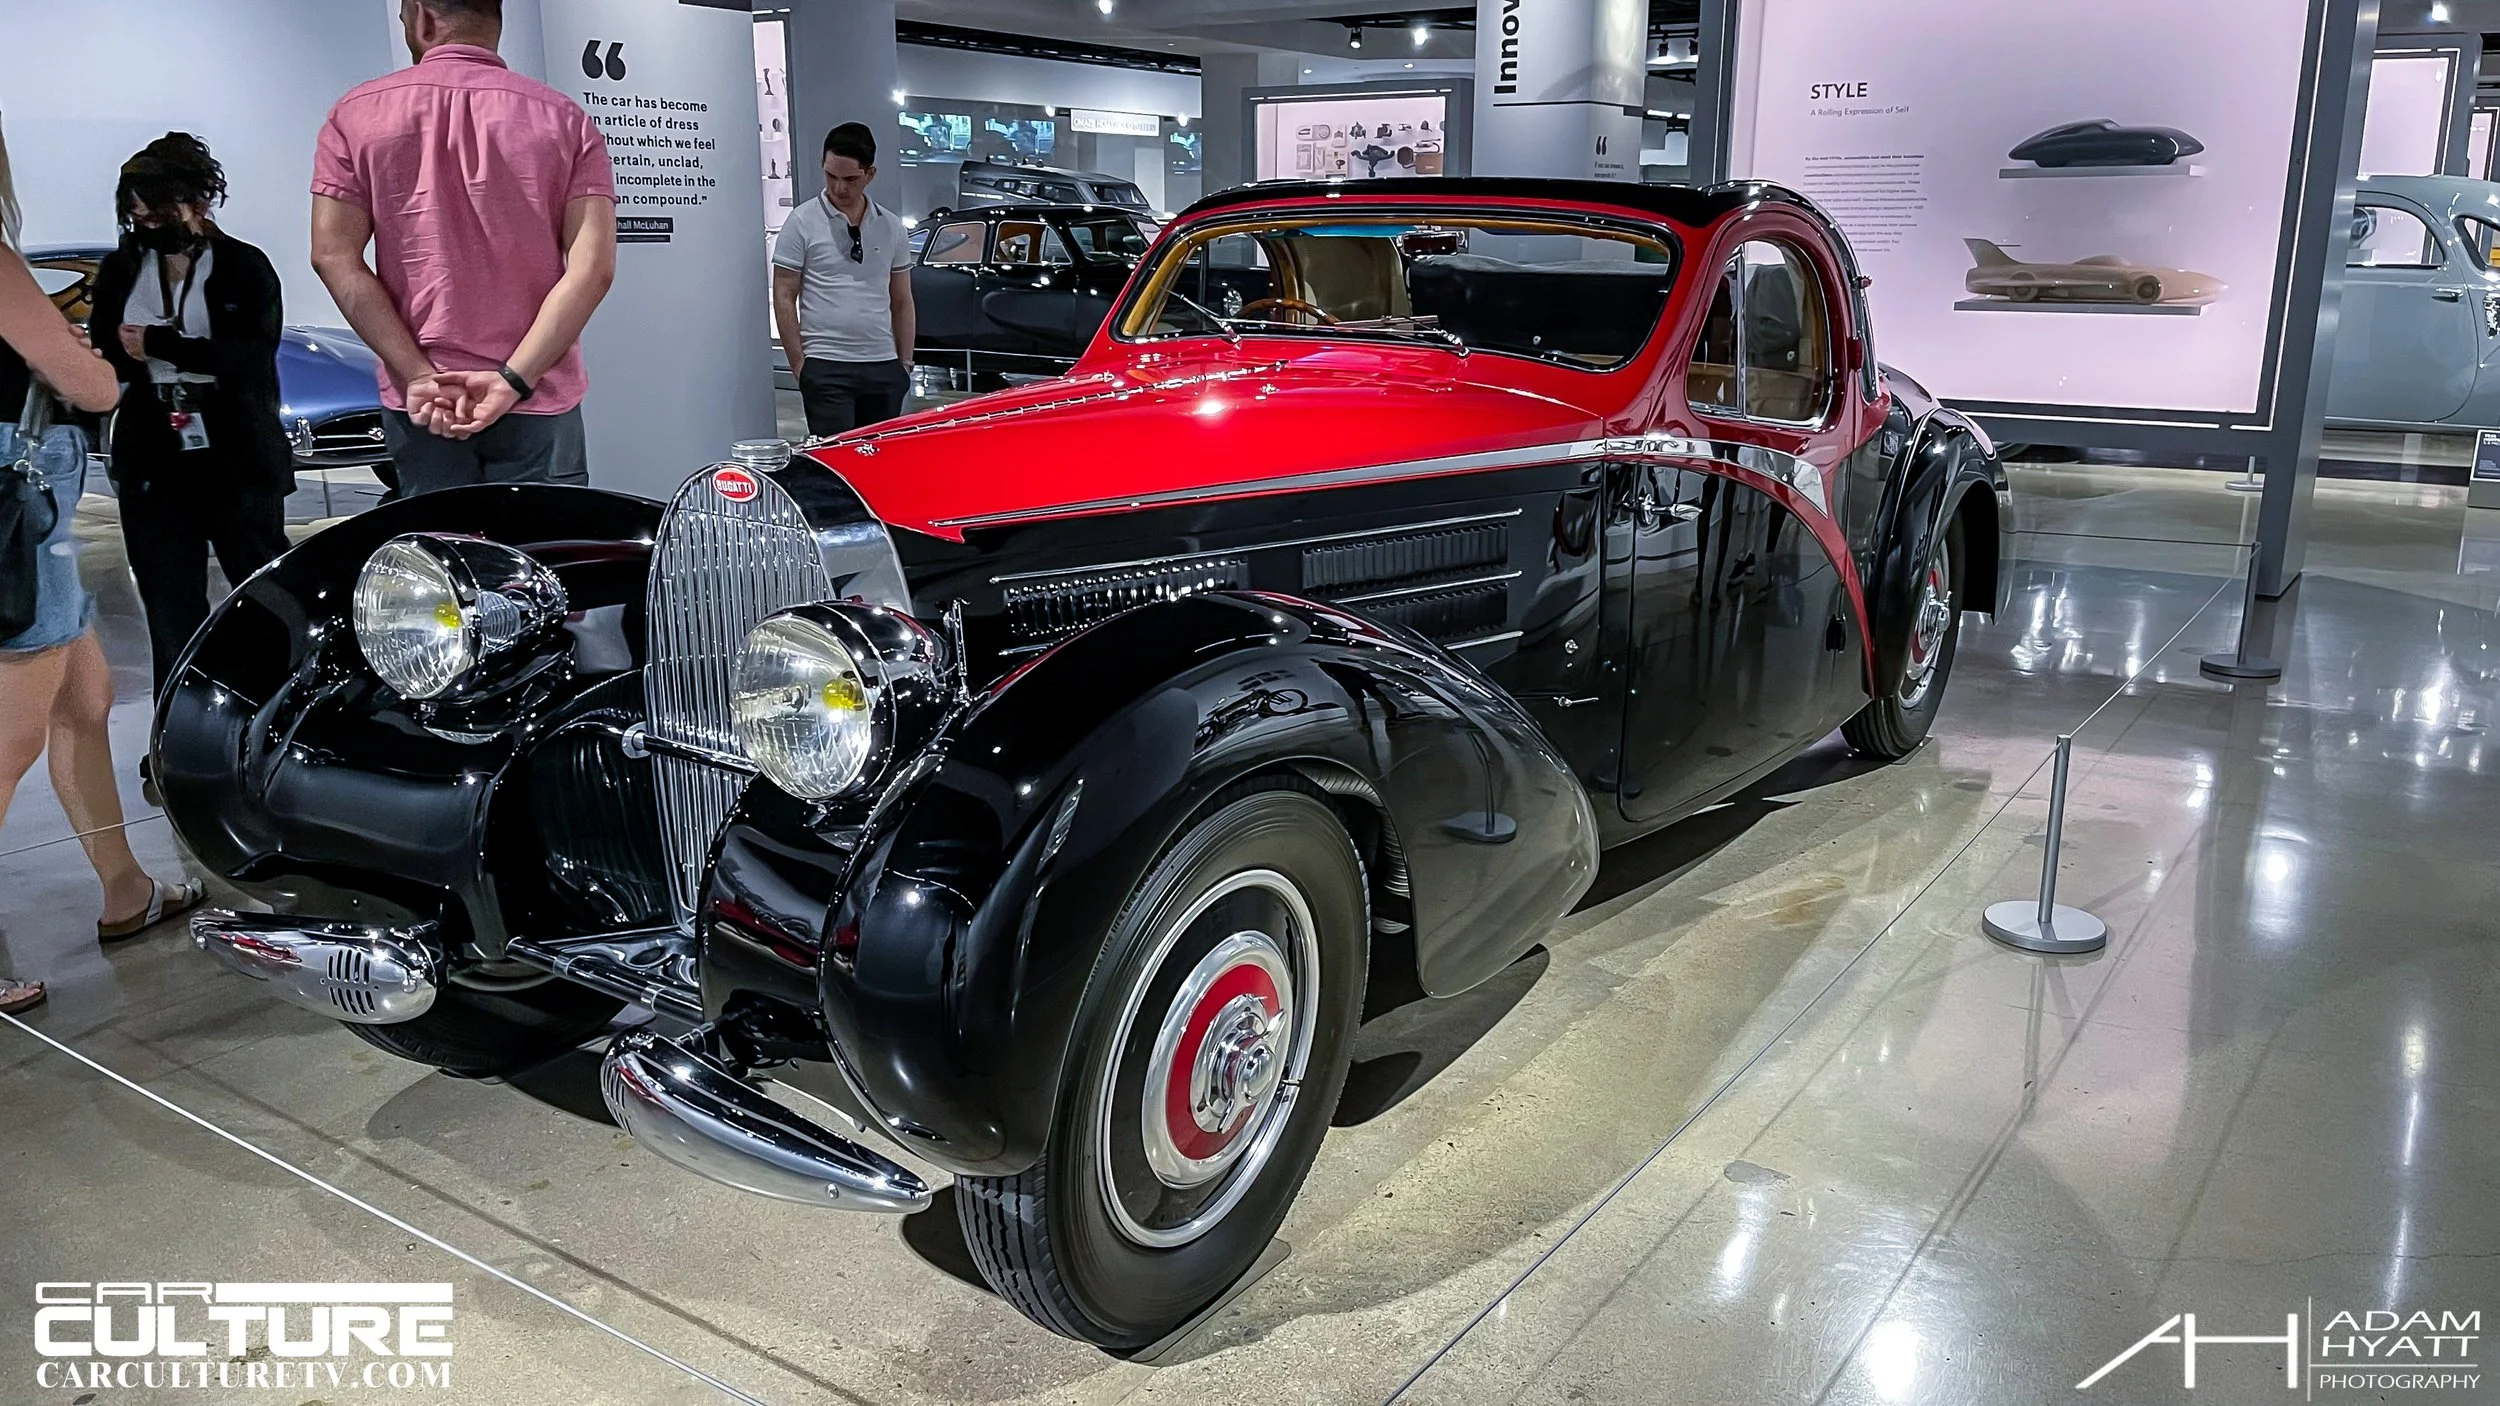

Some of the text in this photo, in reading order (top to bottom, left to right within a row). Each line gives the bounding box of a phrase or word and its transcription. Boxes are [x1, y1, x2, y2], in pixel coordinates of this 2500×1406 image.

[1810, 82, 1868, 100] STYLE
[583, 92, 708, 112] The car has become
[1818, 108, 1842, 117] Rolling
[1844, 107, 1884, 117] Expression
[1885, 106, 1894, 114] of
[1895, 105, 1910, 114] Self
[605, 114, 646, 127] article
[650, 116, 662, 128] of
[665, 117, 699, 131] dress
[637, 135, 672, 148] which
[675, 139, 691, 149] we
[694, 137, 716, 150] feel
[658, 156, 703, 169] unclad,
[615, 172, 716, 188] incomplete in the
[633, 220, 669, 230] McLuhan
[715, 479, 753, 494] BUGATTI
